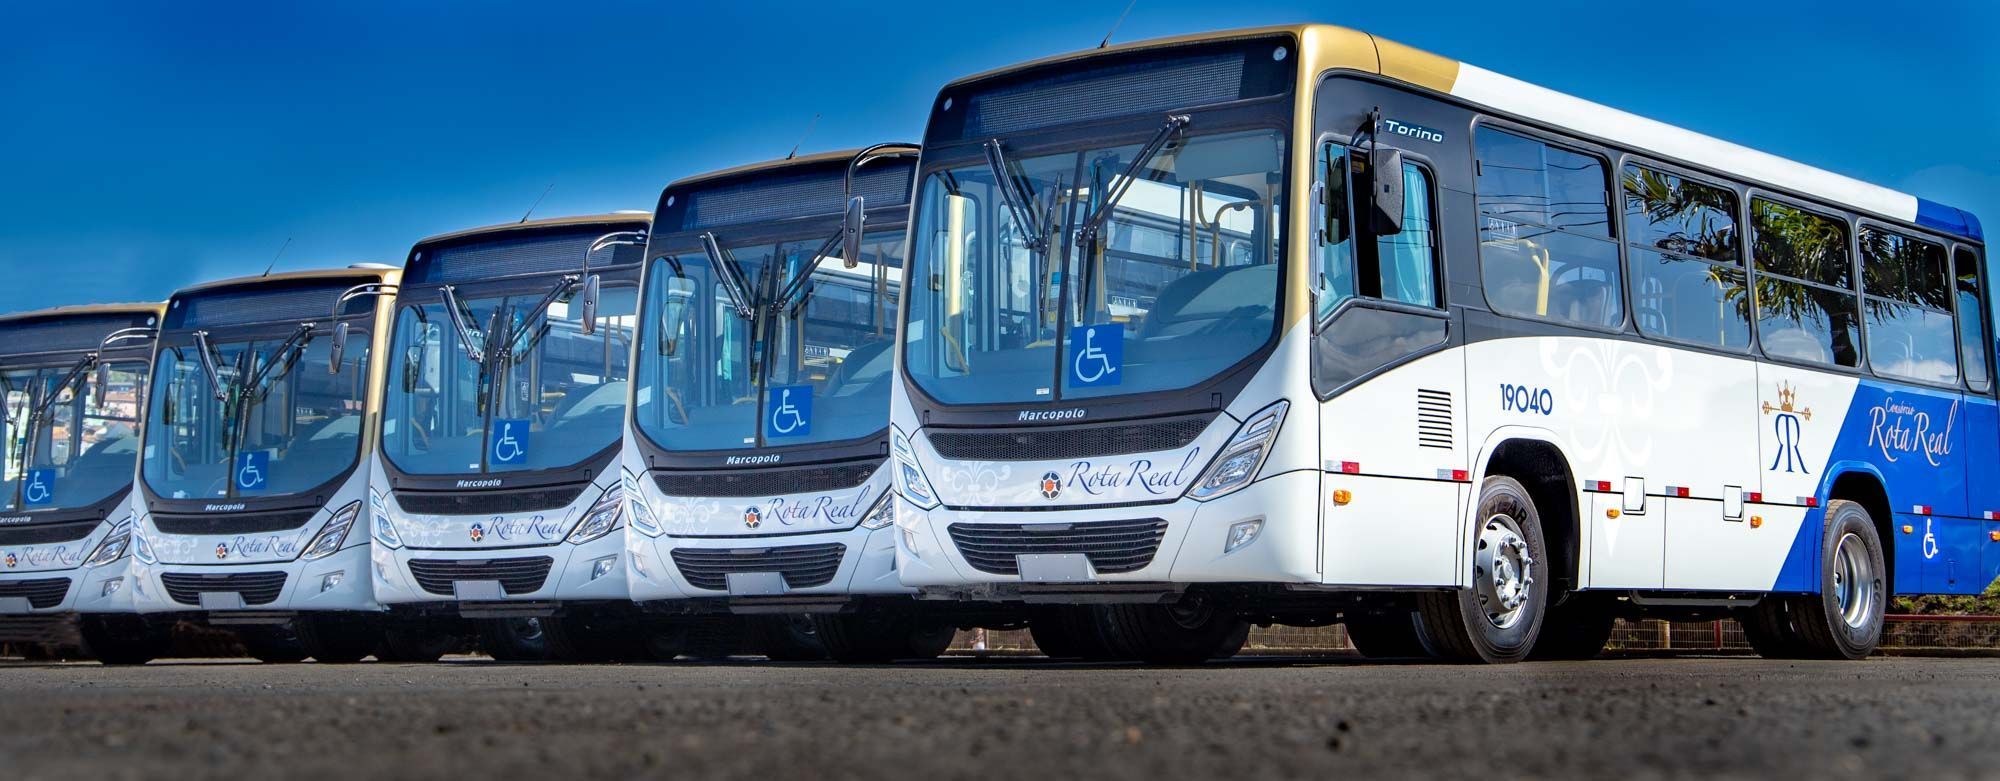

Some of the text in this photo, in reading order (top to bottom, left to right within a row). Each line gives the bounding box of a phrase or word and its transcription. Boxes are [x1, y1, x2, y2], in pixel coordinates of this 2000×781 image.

[1385, 119, 1443, 142] Torino
[1500, 383, 1553, 416] 19040
[1018, 408, 1085, 421] Marcopolo
[1868, 399, 1958, 467] Rota Real
[726, 454, 780, 465] Marcopolo
[1067, 446, 1200, 495] Rota Real
[456, 479, 502, 488] Marcopolo
[205, 503, 245, 512] Marcopolo
[765, 485, 871, 526] Rota Real
[488, 506, 577, 540] Rota Real
[20, 538, 92, 567] Rota Real
[230, 528, 308, 558] Rota Real
